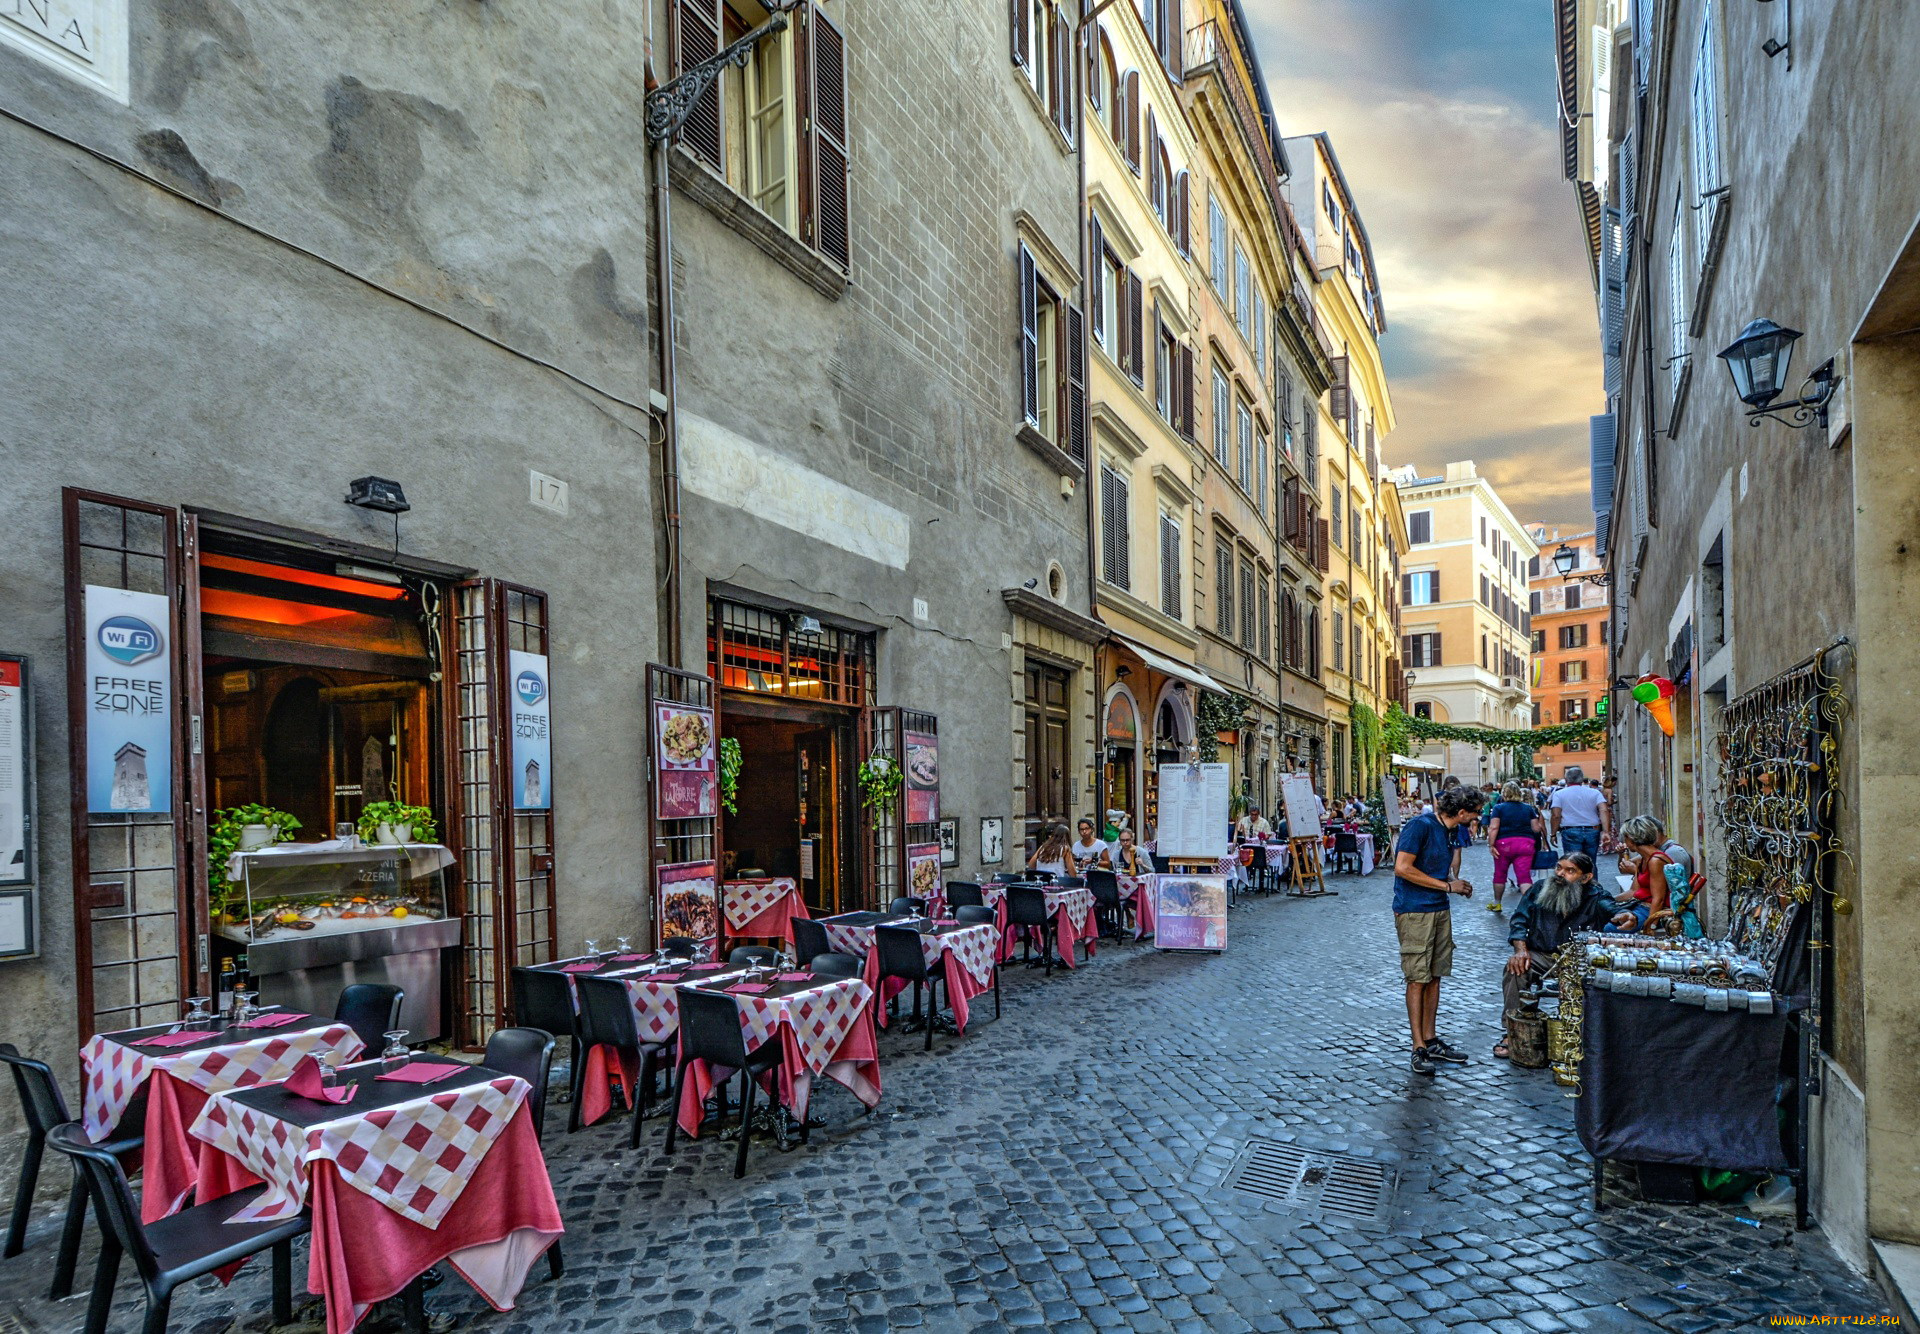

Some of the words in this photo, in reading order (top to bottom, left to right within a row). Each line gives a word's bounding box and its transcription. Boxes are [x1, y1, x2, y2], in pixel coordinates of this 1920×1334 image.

[916, 602, 925, 616] 18
[95, 676, 162, 696] FREE
[95, 692, 163, 711] ZONE
[516, 713, 546, 726] FREE
[516, 724, 547, 738] ZONE
[670, 782, 696, 803] TORRE
